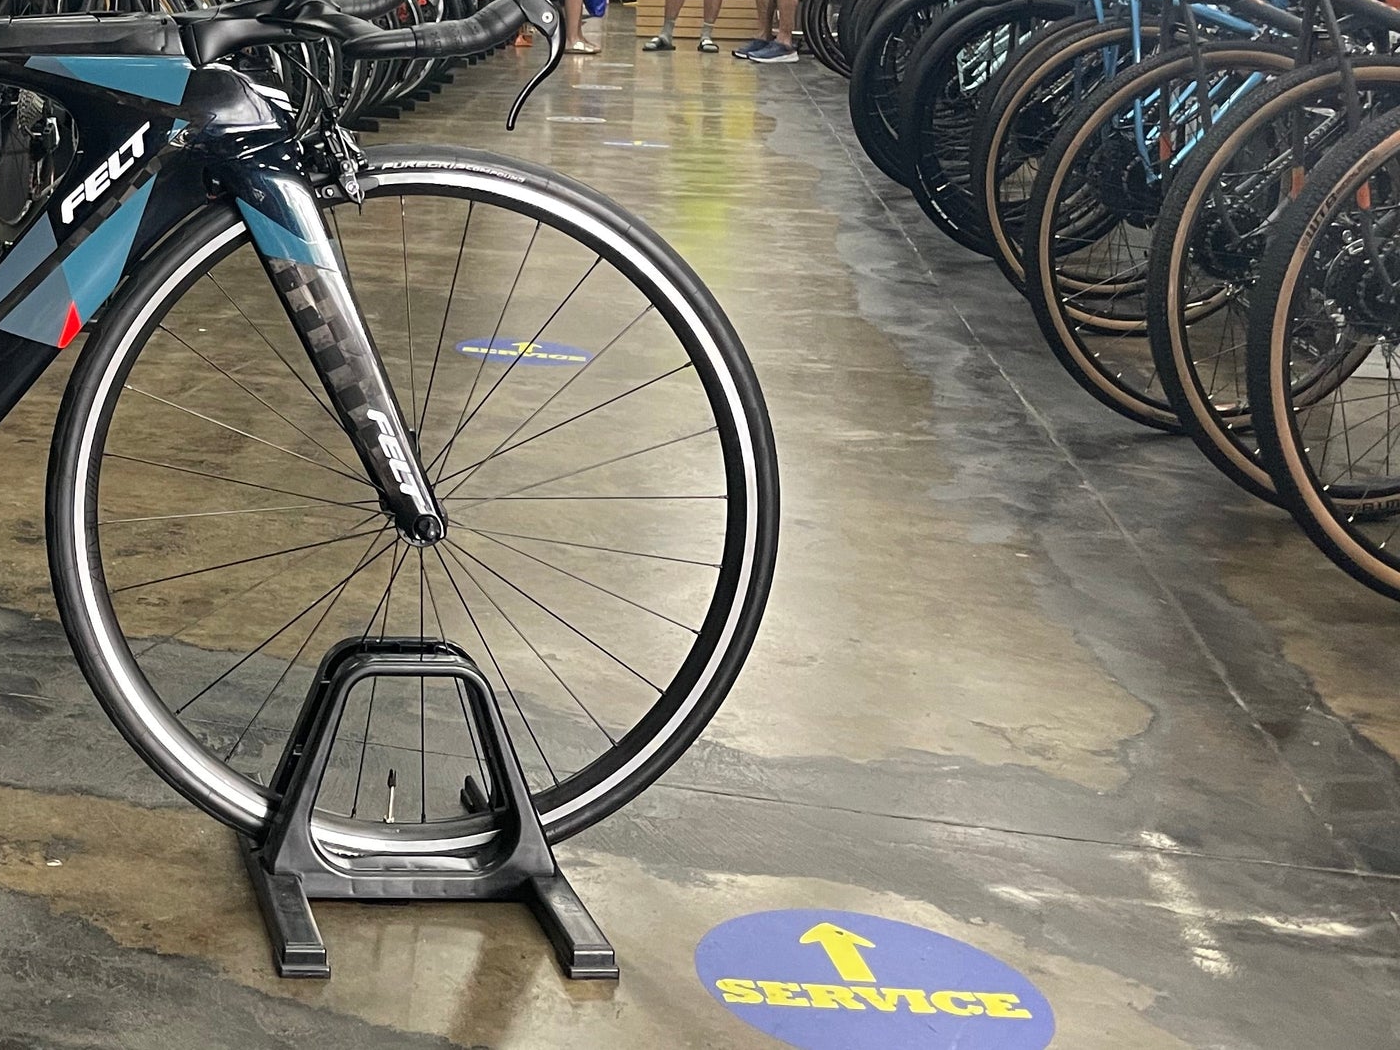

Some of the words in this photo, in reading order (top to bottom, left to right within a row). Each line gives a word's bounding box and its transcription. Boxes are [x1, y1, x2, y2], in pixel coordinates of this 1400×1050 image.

[61, 121, 150, 224] FELT
[462, 346, 586, 361] SERVICE
[367, 409, 428, 514] FELT
[715, 978, 1033, 1019] SERVICE
